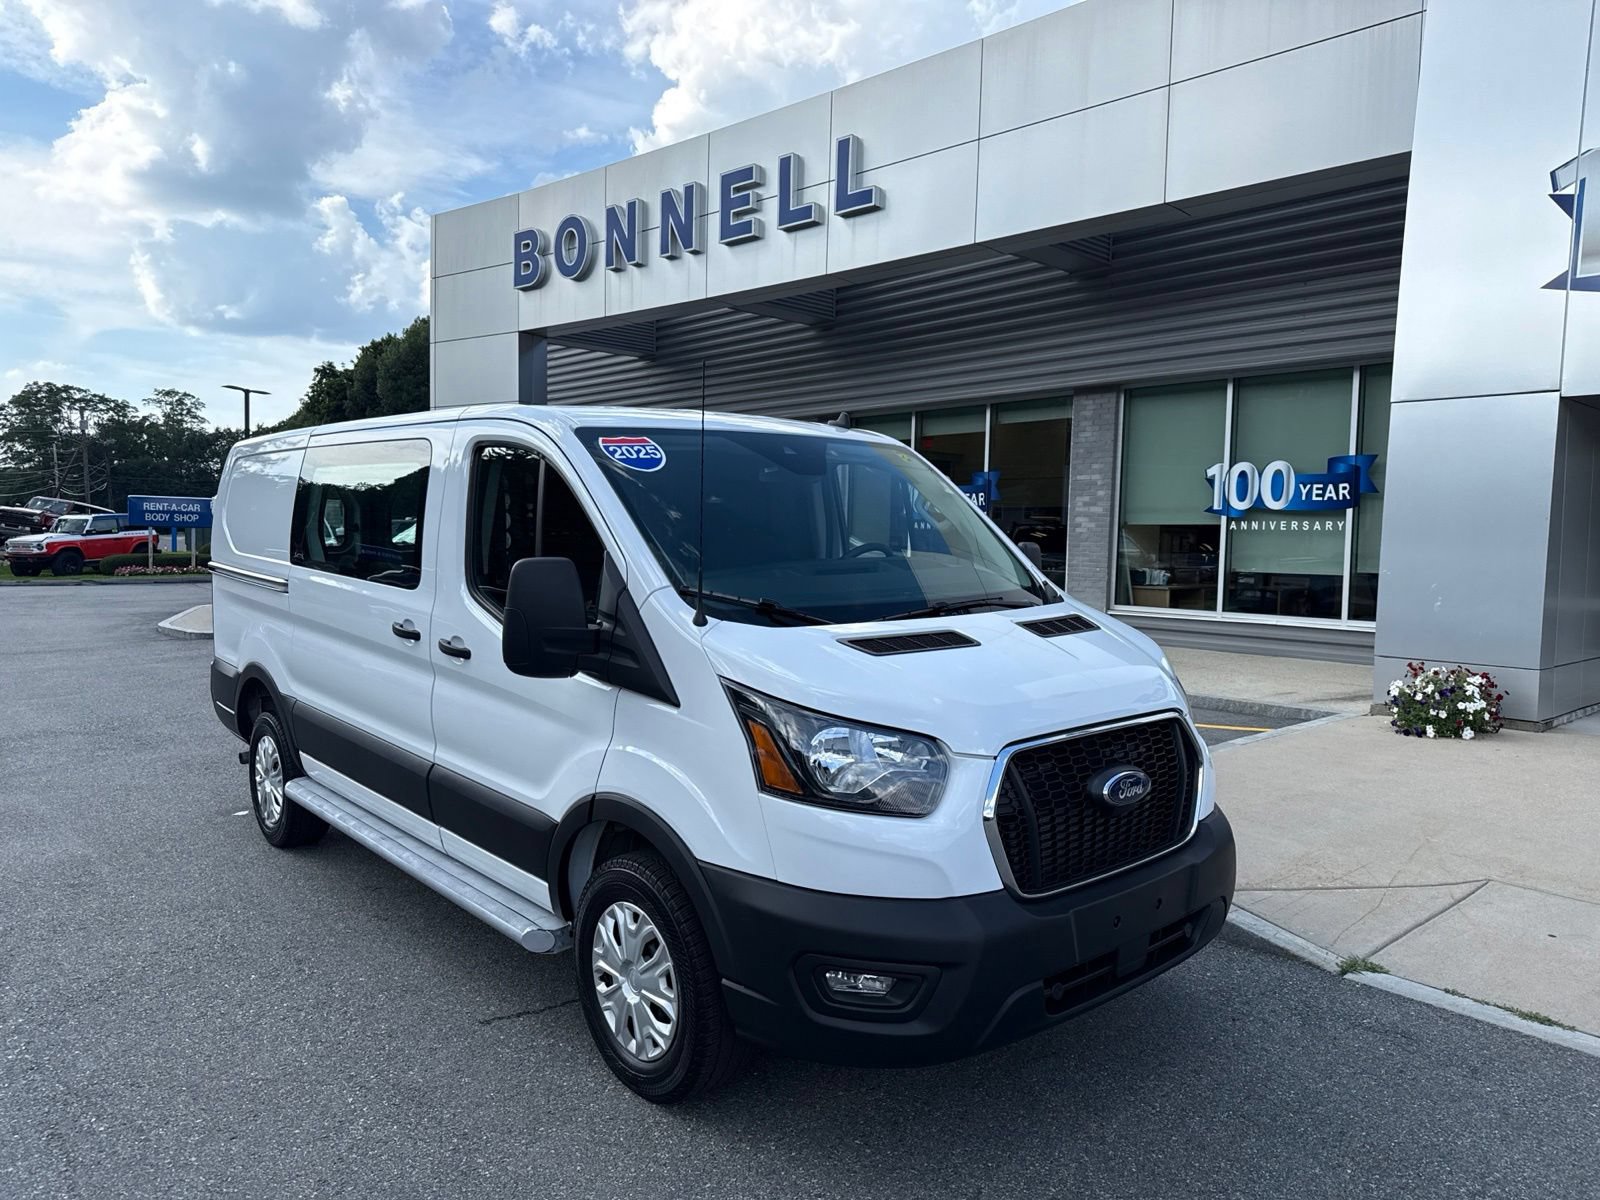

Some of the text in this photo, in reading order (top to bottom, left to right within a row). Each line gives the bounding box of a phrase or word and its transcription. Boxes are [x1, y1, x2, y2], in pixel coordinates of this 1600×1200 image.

[513, 133, 886, 291] BONNELL
[609, 445, 661, 459] 2025
[1206, 460, 1351, 511] 100 YEAR
[143, 502, 201, 512] RENT-A-CAR
[145, 513, 200, 522] BODY SHOP
[1229, 520, 1346, 531] ANNIVERSARY
[1118, 776, 1145, 800] Ford
